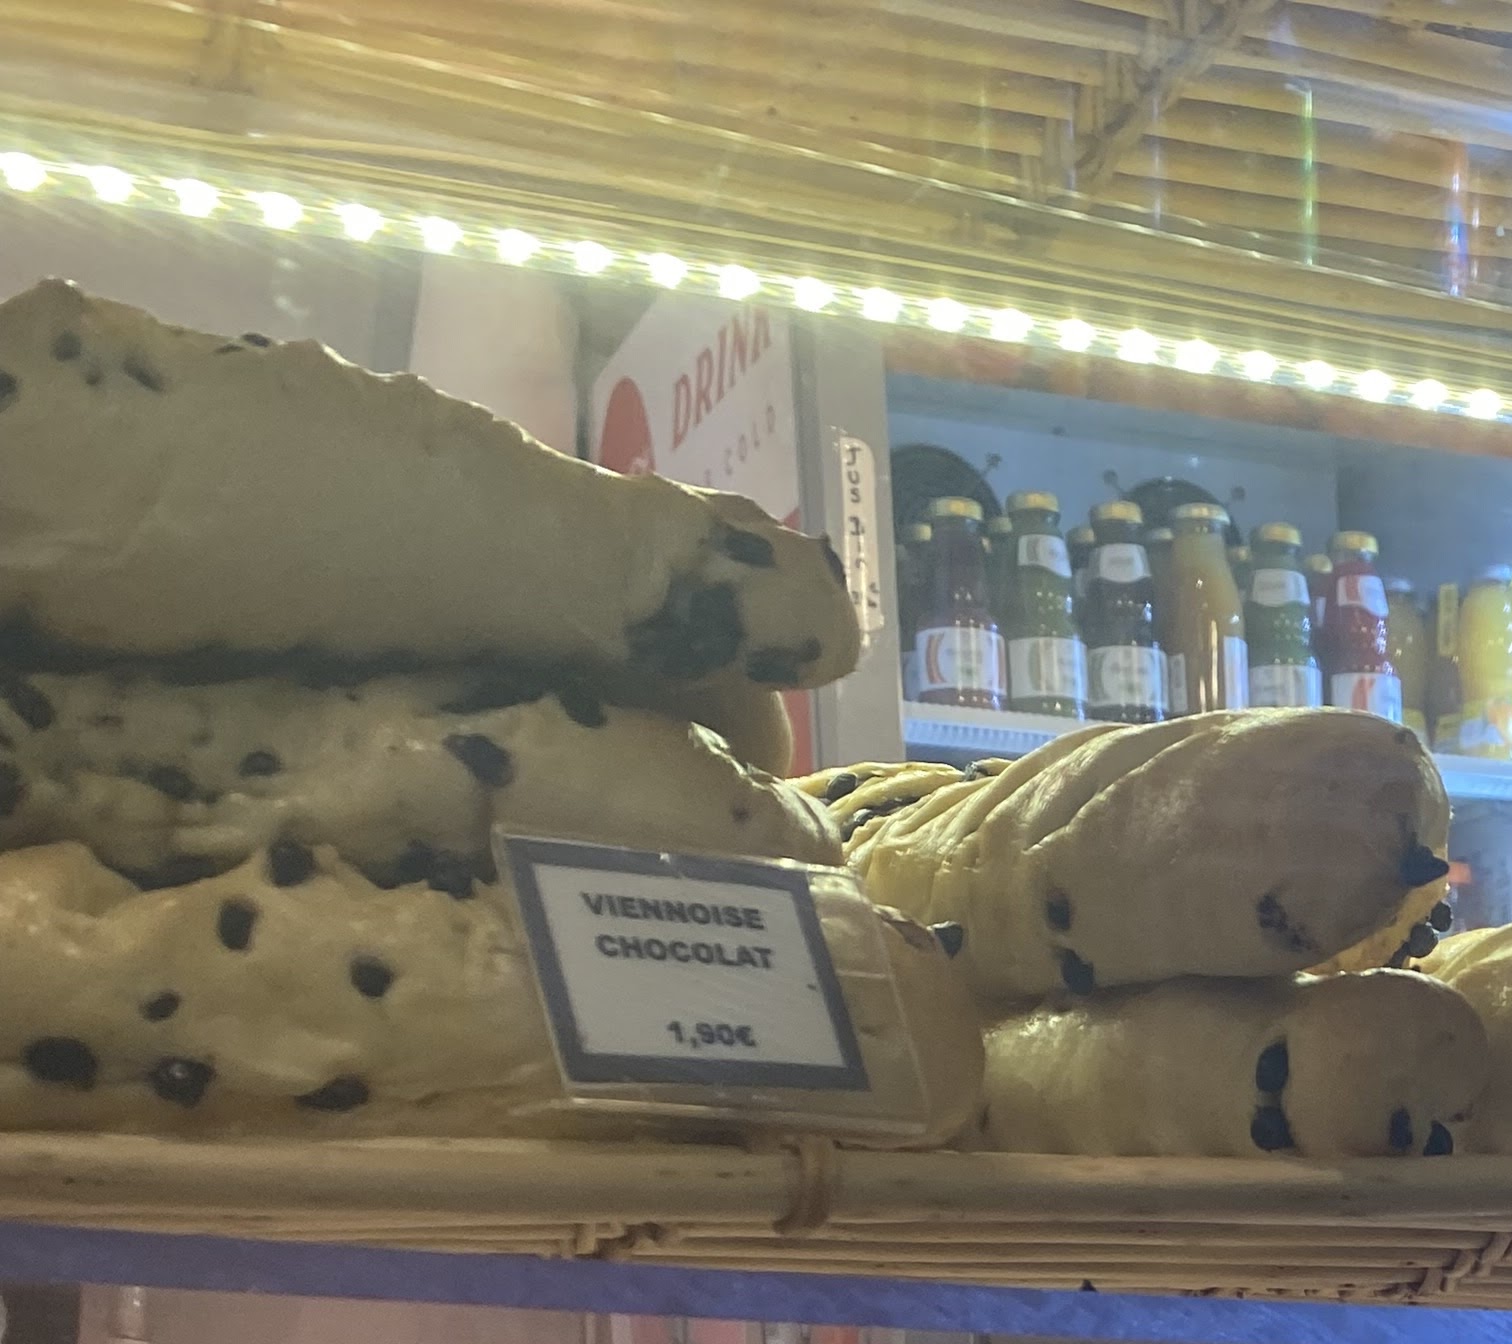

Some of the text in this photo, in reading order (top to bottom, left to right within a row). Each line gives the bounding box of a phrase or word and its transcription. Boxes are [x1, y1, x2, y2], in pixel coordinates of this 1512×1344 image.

[581, 892, 765, 932] VIENNOISE
[596, 935, 774, 969] CHOCOLAT
[667, 1020, 756, 1048] 1,90€
